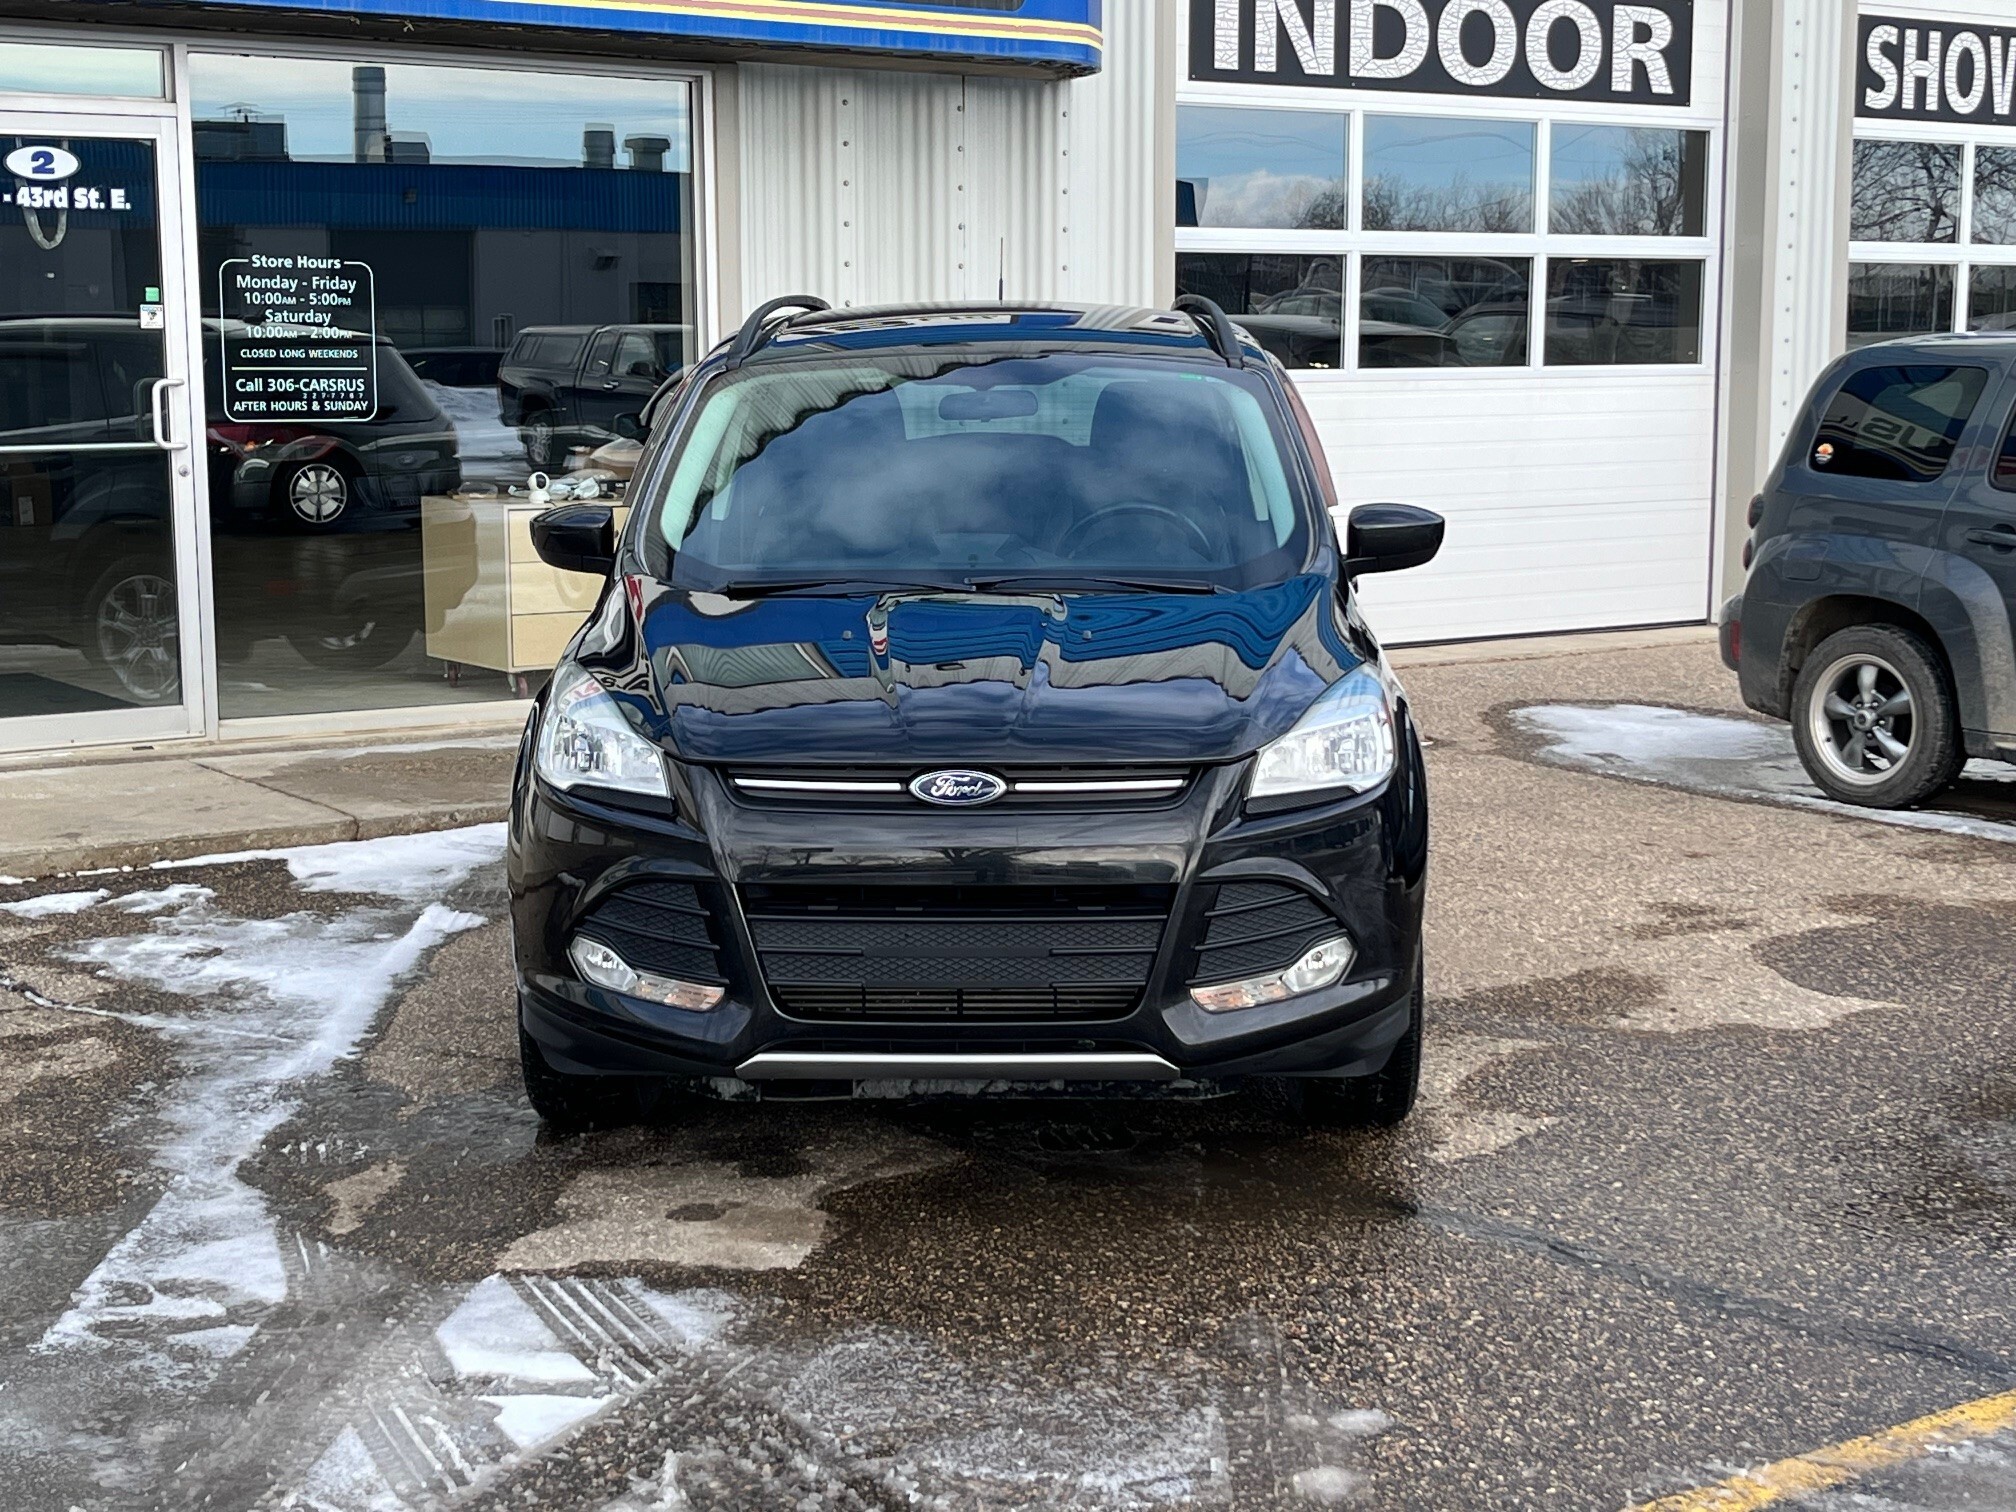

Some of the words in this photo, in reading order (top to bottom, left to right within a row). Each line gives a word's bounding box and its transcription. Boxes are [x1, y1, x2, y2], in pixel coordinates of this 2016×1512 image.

[1213, 0, 1674, 95] INDOOR
[31, 150, 55, 174] 2
[17, 187, 68, 208] 43rd
[74, 188, 105, 209] St.
[111, 189, 131, 209] E.
[251, 254, 293, 268] Store
[297, 256, 342, 269] Hours
[236, 275, 299, 292] Monday
[311, 276, 357, 293] Friday
[243, 292, 297, 305] 10:00AM
[308, 293, 352, 306] 5:00PM
[265, 309, 332, 326] Saturday
[246, 326, 298, 339] 10:00AM
[309, 327, 353, 339] 2:00PM
[240, 349, 277, 358] CLOSED
[279, 349, 306, 359] LONG
[308, 350, 359, 359] WEEKENDS
[235, 378, 263, 392] Call
[267, 378, 365, 392] 306-CARSRUS
[233, 401, 267, 412] AFTER
[270, 401, 308, 411] HOURS
[311, 401, 321, 411] &
[324, 401, 369, 412] SUNDAY
[930, 775, 983, 797] Ford
